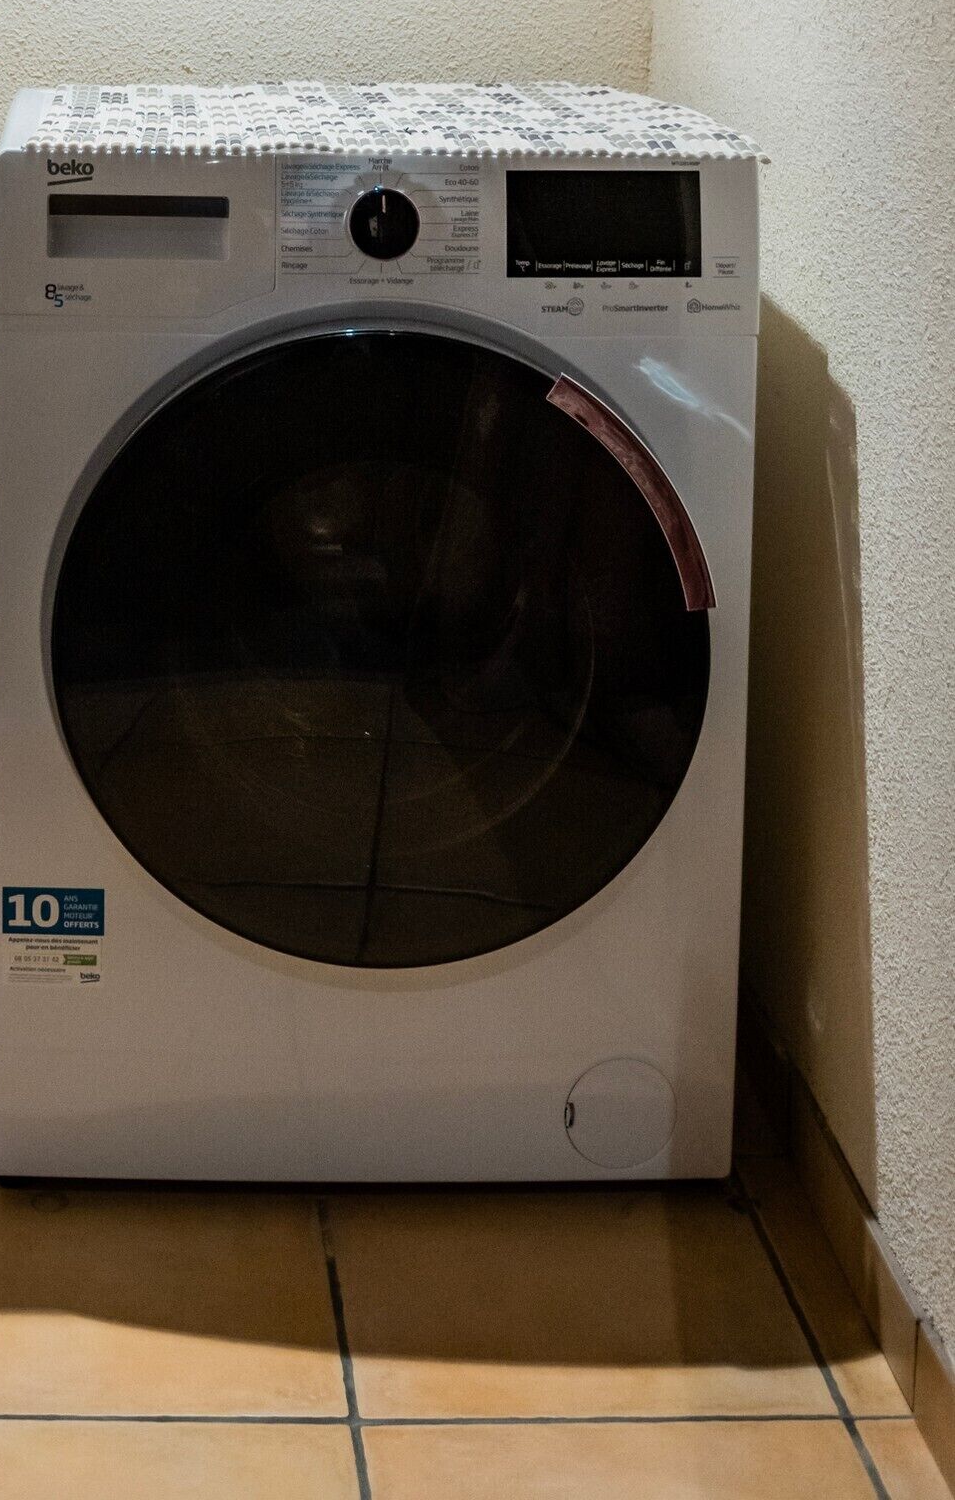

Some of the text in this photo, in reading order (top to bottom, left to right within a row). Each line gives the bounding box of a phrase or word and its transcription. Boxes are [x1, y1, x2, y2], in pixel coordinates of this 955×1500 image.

[46, 158, 95, 176] beko
[444, 178, 480, 186] Eco 40-60
[280, 244, 314, 252] Chemises
[45, 283, 57, 300] 8
[54, 293, 64, 308] 5
[63, 895, 78, 903] ANS
[7, 893, 60, 928] 10
[63, 903, 99, 911] GARANTIE
[63, 920, 100, 929] OFFERTS
[79, 971, 101, 980] beko
